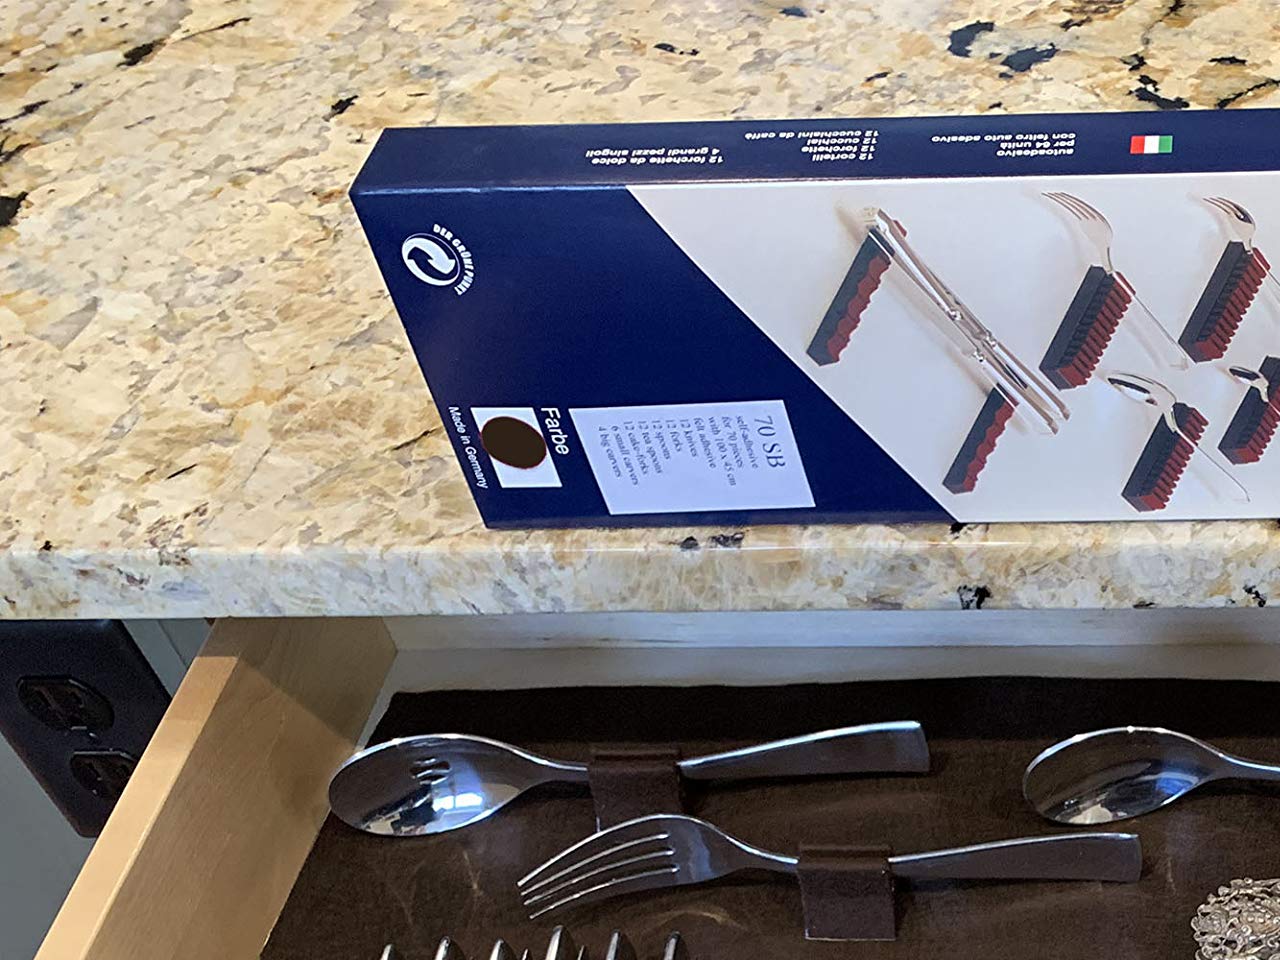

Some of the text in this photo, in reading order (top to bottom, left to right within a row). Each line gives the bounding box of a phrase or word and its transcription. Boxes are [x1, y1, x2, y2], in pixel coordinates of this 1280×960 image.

[668, 147, 708, 155] grandi
[798, 131, 861, 139] cucchiaini
[586, 149, 629, 157] singoli
[433, 223, 453, 240] DER
[541, 407, 569, 454] Farbe
[599, 433, 615, 447] big
[652, 420, 671, 459] 12 spoons
[666, 420, 683, 452] 12 forks
[680, 419, 698, 457] 12 knives
[693, 417, 717, 468] felt adhesive
[708, 416, 721, 435] with
[721, 416, 744, 468] for 70 pieces
[736, 416, 759, 468] self-adhesive
[754, 416, 786, 468] 70 SB
[449, 406, 488, 488] Made in Germany
[614, 434, 630, 454] small
[623, 457, 639, 485] carvers
[624, 422, 649, 474] 12 cake-forks
[638, 421, 663, 474] 12 tea spoons
[715, 438, 727, 452] 100
[605, 449, 623, 478] carvers
[724, 462, 733, 471] 45
[727, 473, 736, 486] cm
